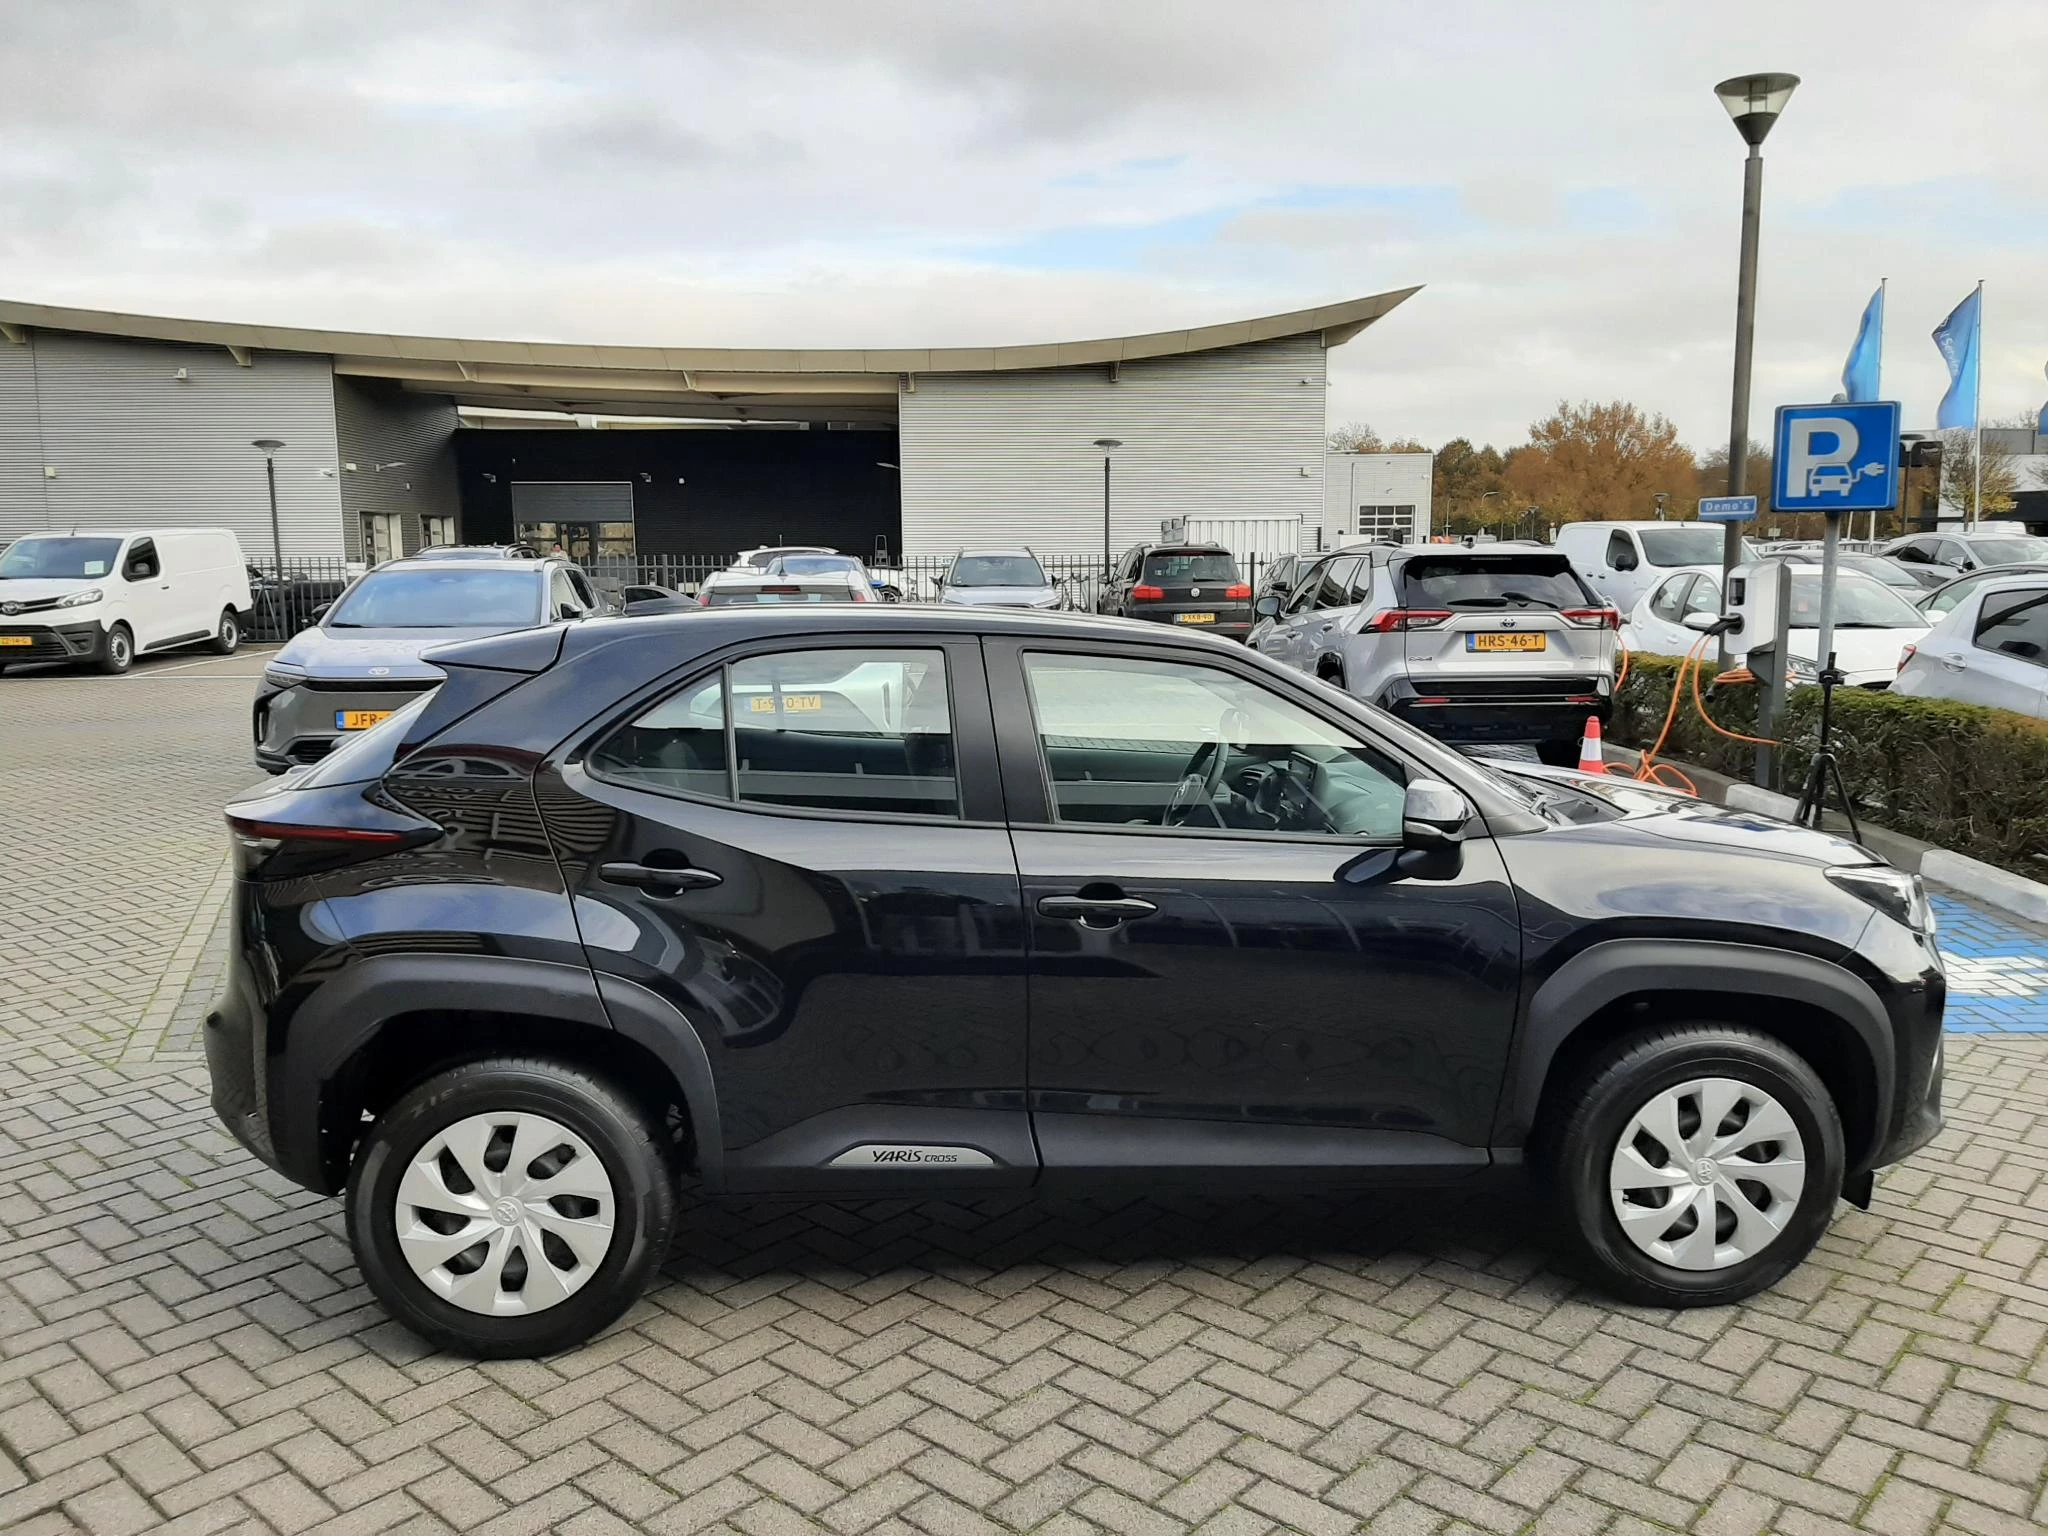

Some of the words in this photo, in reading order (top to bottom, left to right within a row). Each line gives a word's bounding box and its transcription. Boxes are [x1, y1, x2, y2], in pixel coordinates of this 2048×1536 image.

[1786, 417, 1859, 498] P
[1705, 500, 1750, 511] Demo's
[1477, 634, 1540, 647] HRS-46-T
[755, 696, 816, 710] T-90-TV
[351, 712, 392, 726] JFR-
[924, 1154, 958, 1163] CROSS
